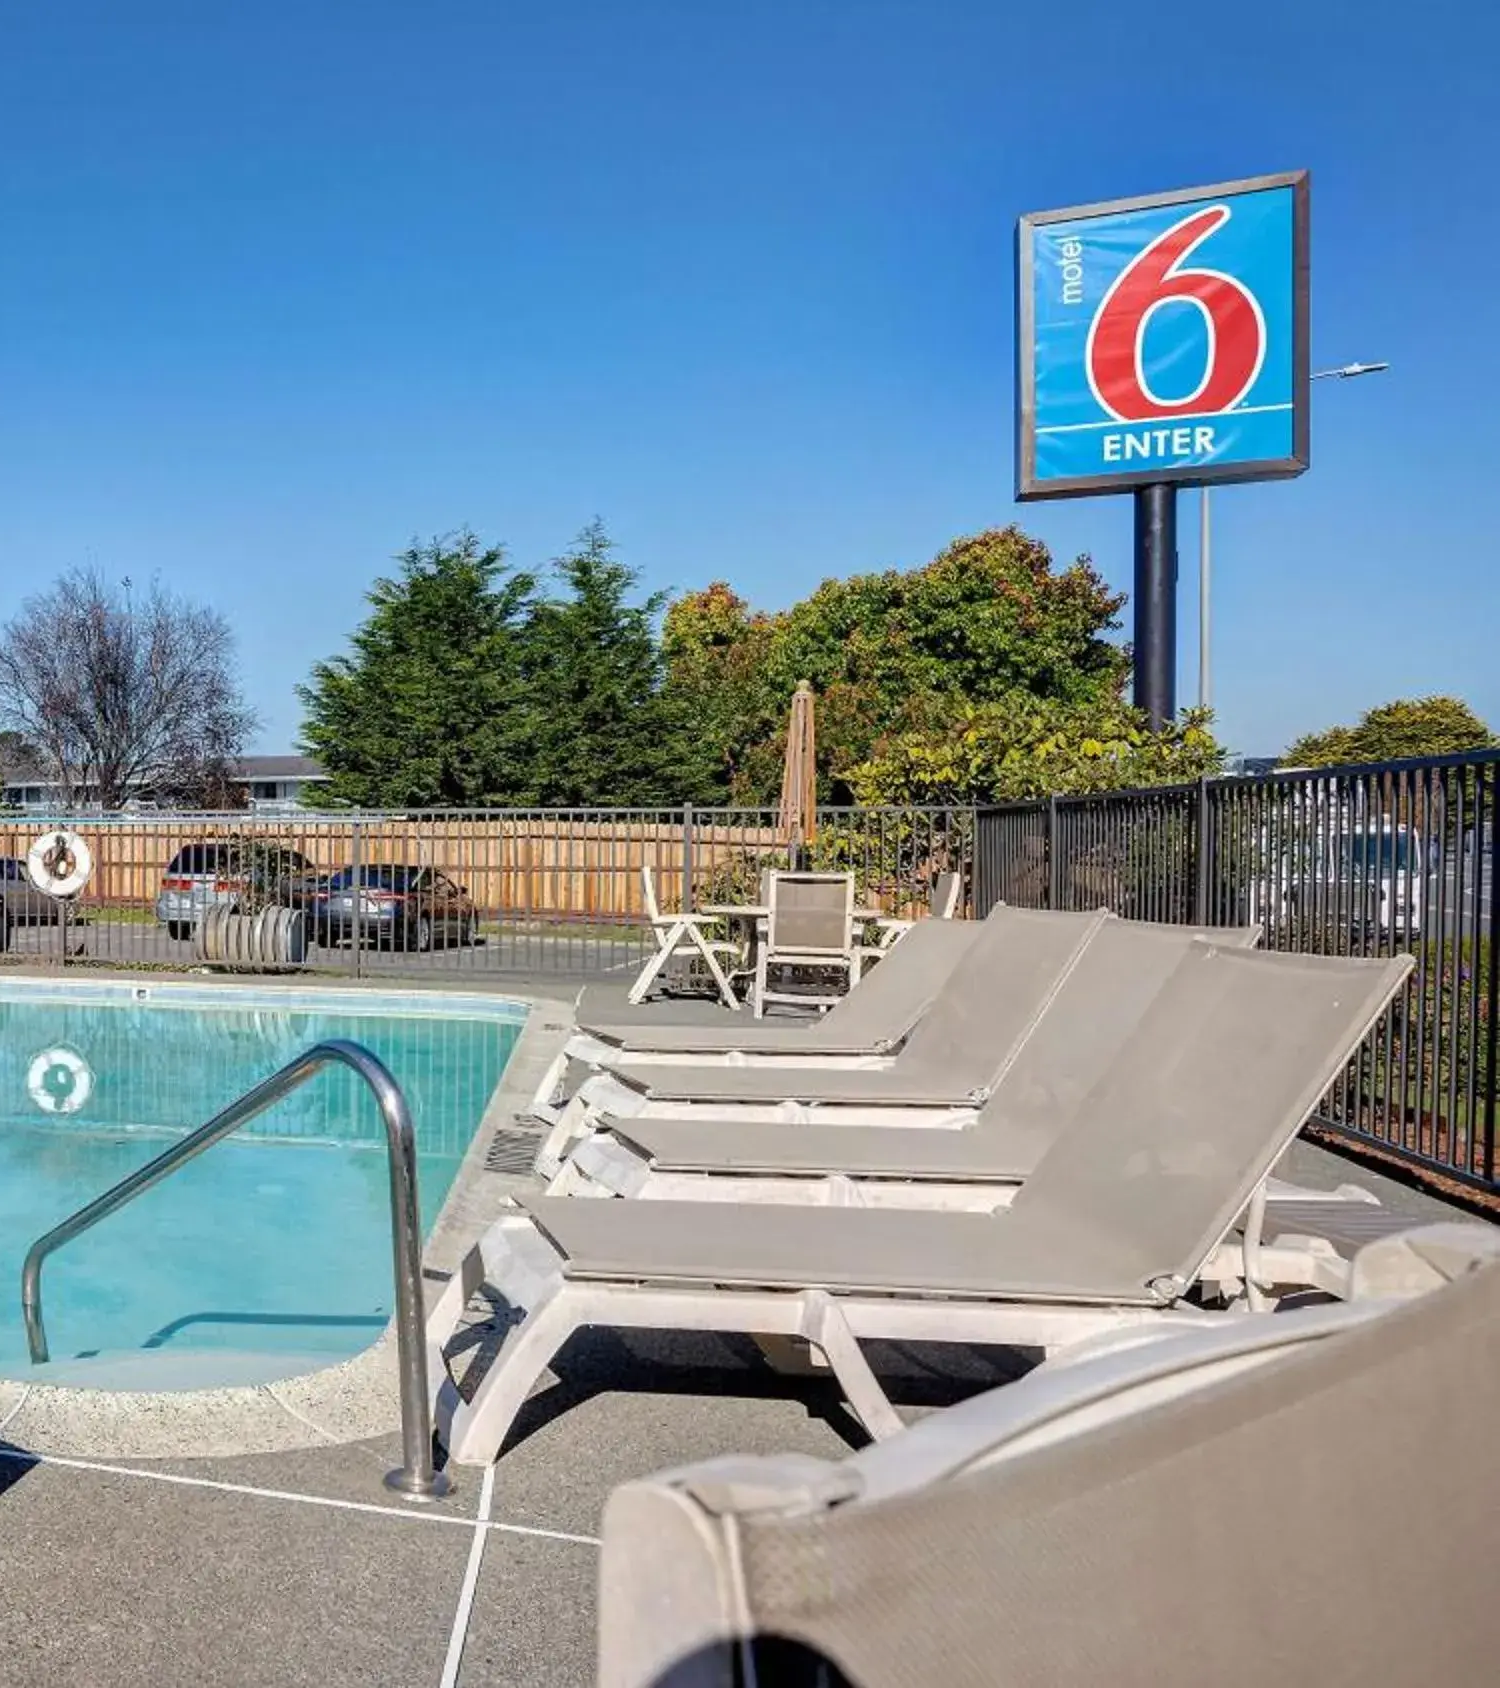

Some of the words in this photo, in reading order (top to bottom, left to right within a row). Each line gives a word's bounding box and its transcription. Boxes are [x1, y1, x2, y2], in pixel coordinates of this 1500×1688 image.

[1060, 235, 1083, 305] motel
[1085, 204, 1267, 422] 6
[1103, 426, 1216, 462] ENTER
